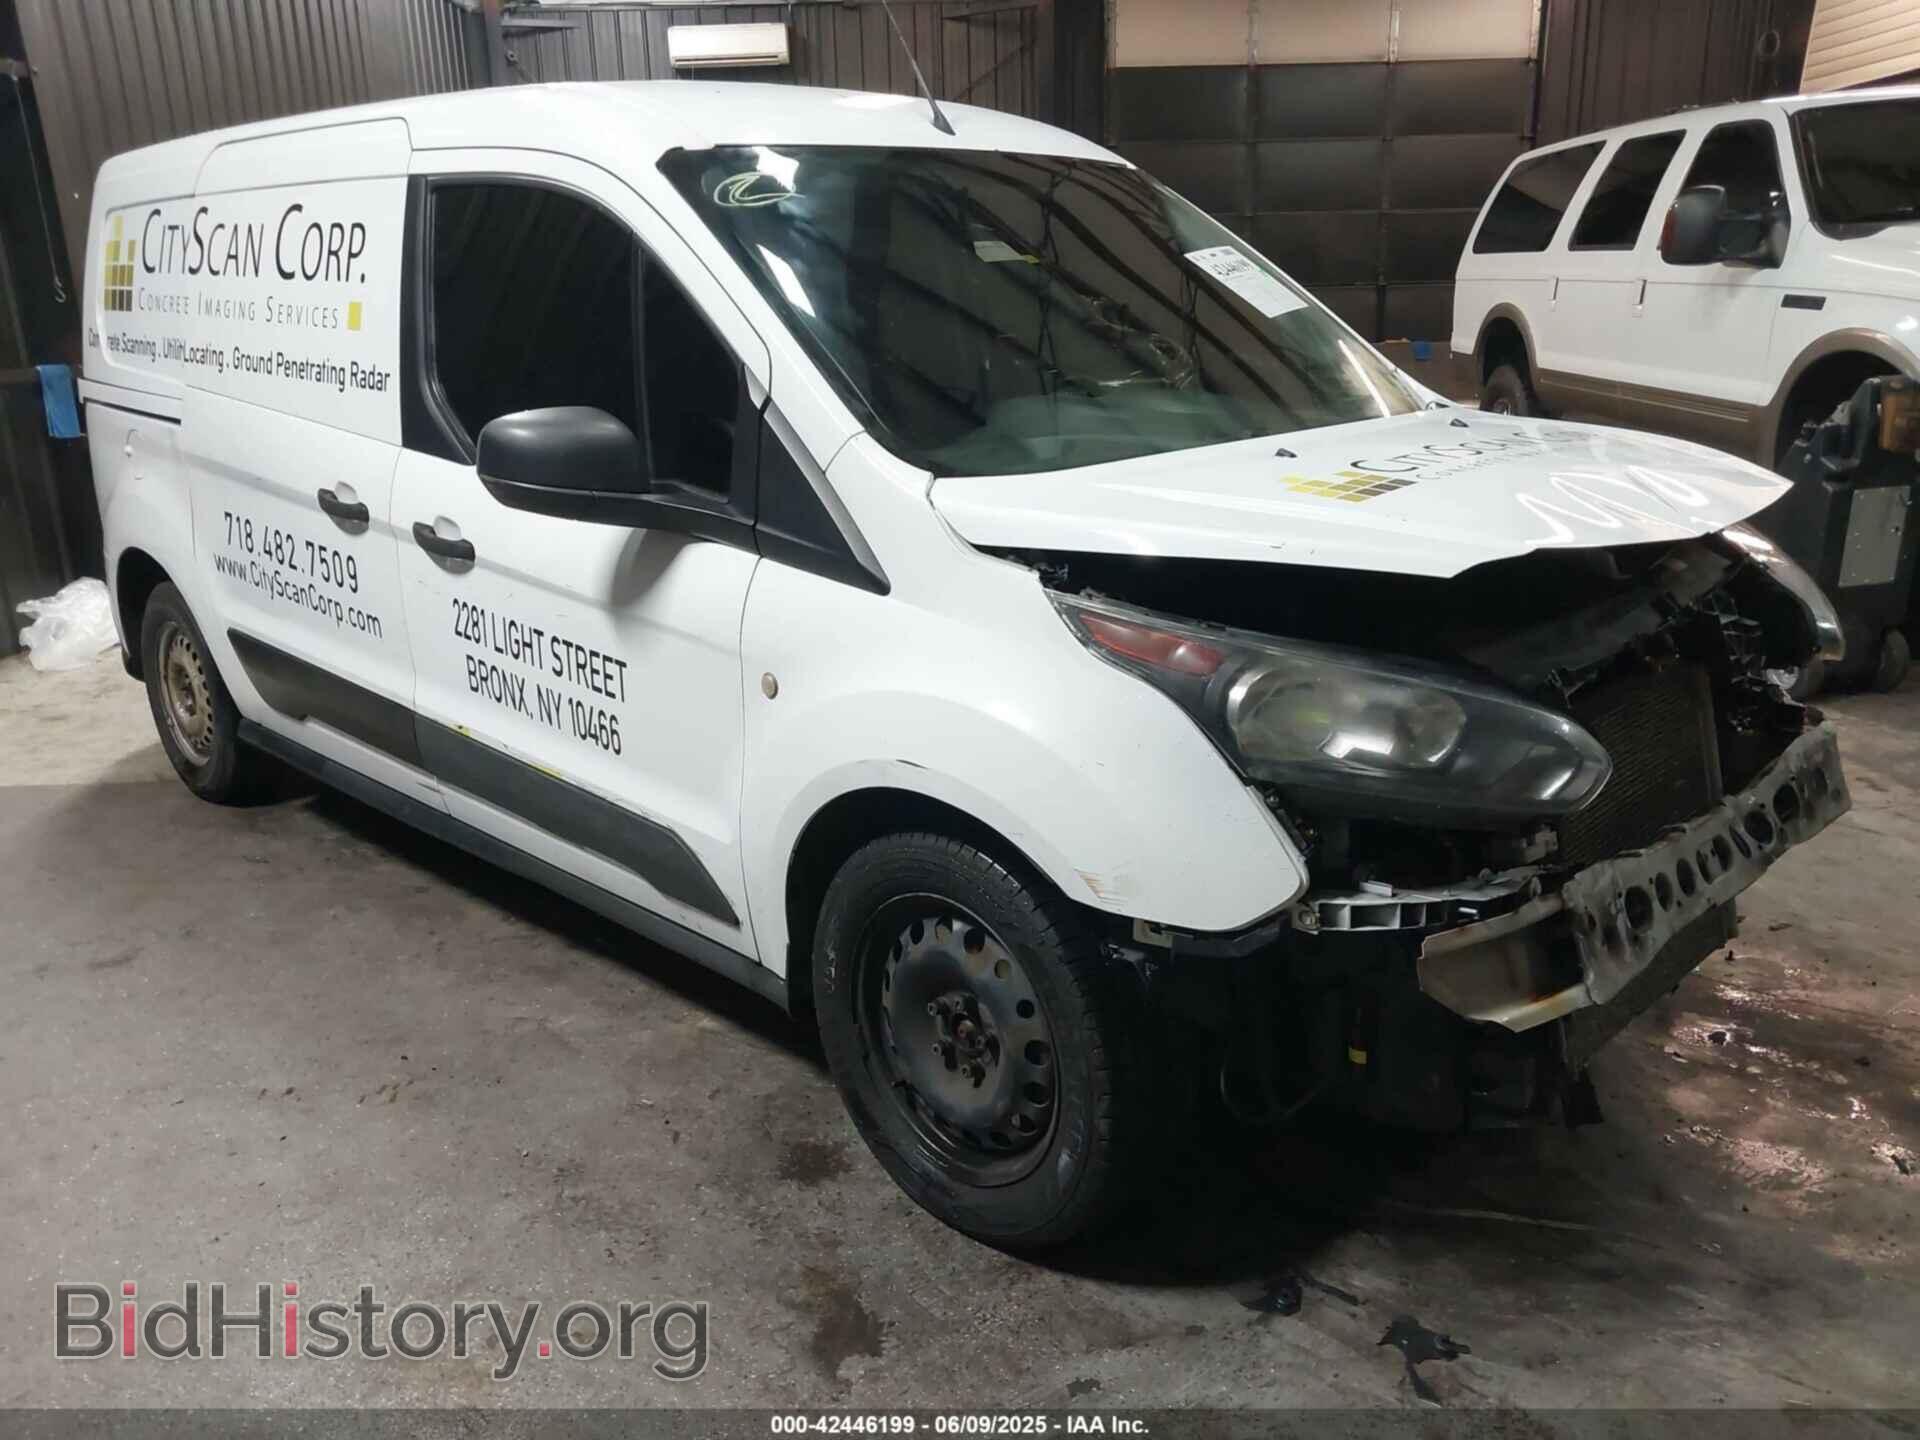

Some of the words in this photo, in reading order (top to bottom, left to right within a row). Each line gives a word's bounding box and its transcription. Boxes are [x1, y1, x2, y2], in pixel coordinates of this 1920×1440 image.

[198, 291, 255, 321] IMAGING
[265, 296, 338, 328] SERVICES
[233, 346, 273, 375] Ground
[276, 351, 345, 392] Penetrating
[350, 361, 390, 392] Radar
[224, 512, 358, 593] 718.482.7509
[214, 552, 383, 639] www.CityScanCorp.com
[453, 598, 489, 646] 2281
[491, 612, 544, 670] LIGHT
[550, 635, 627, 702] STREET
[537, 683, 562, 730] NY
[568, 697, 622, 755] 10466
